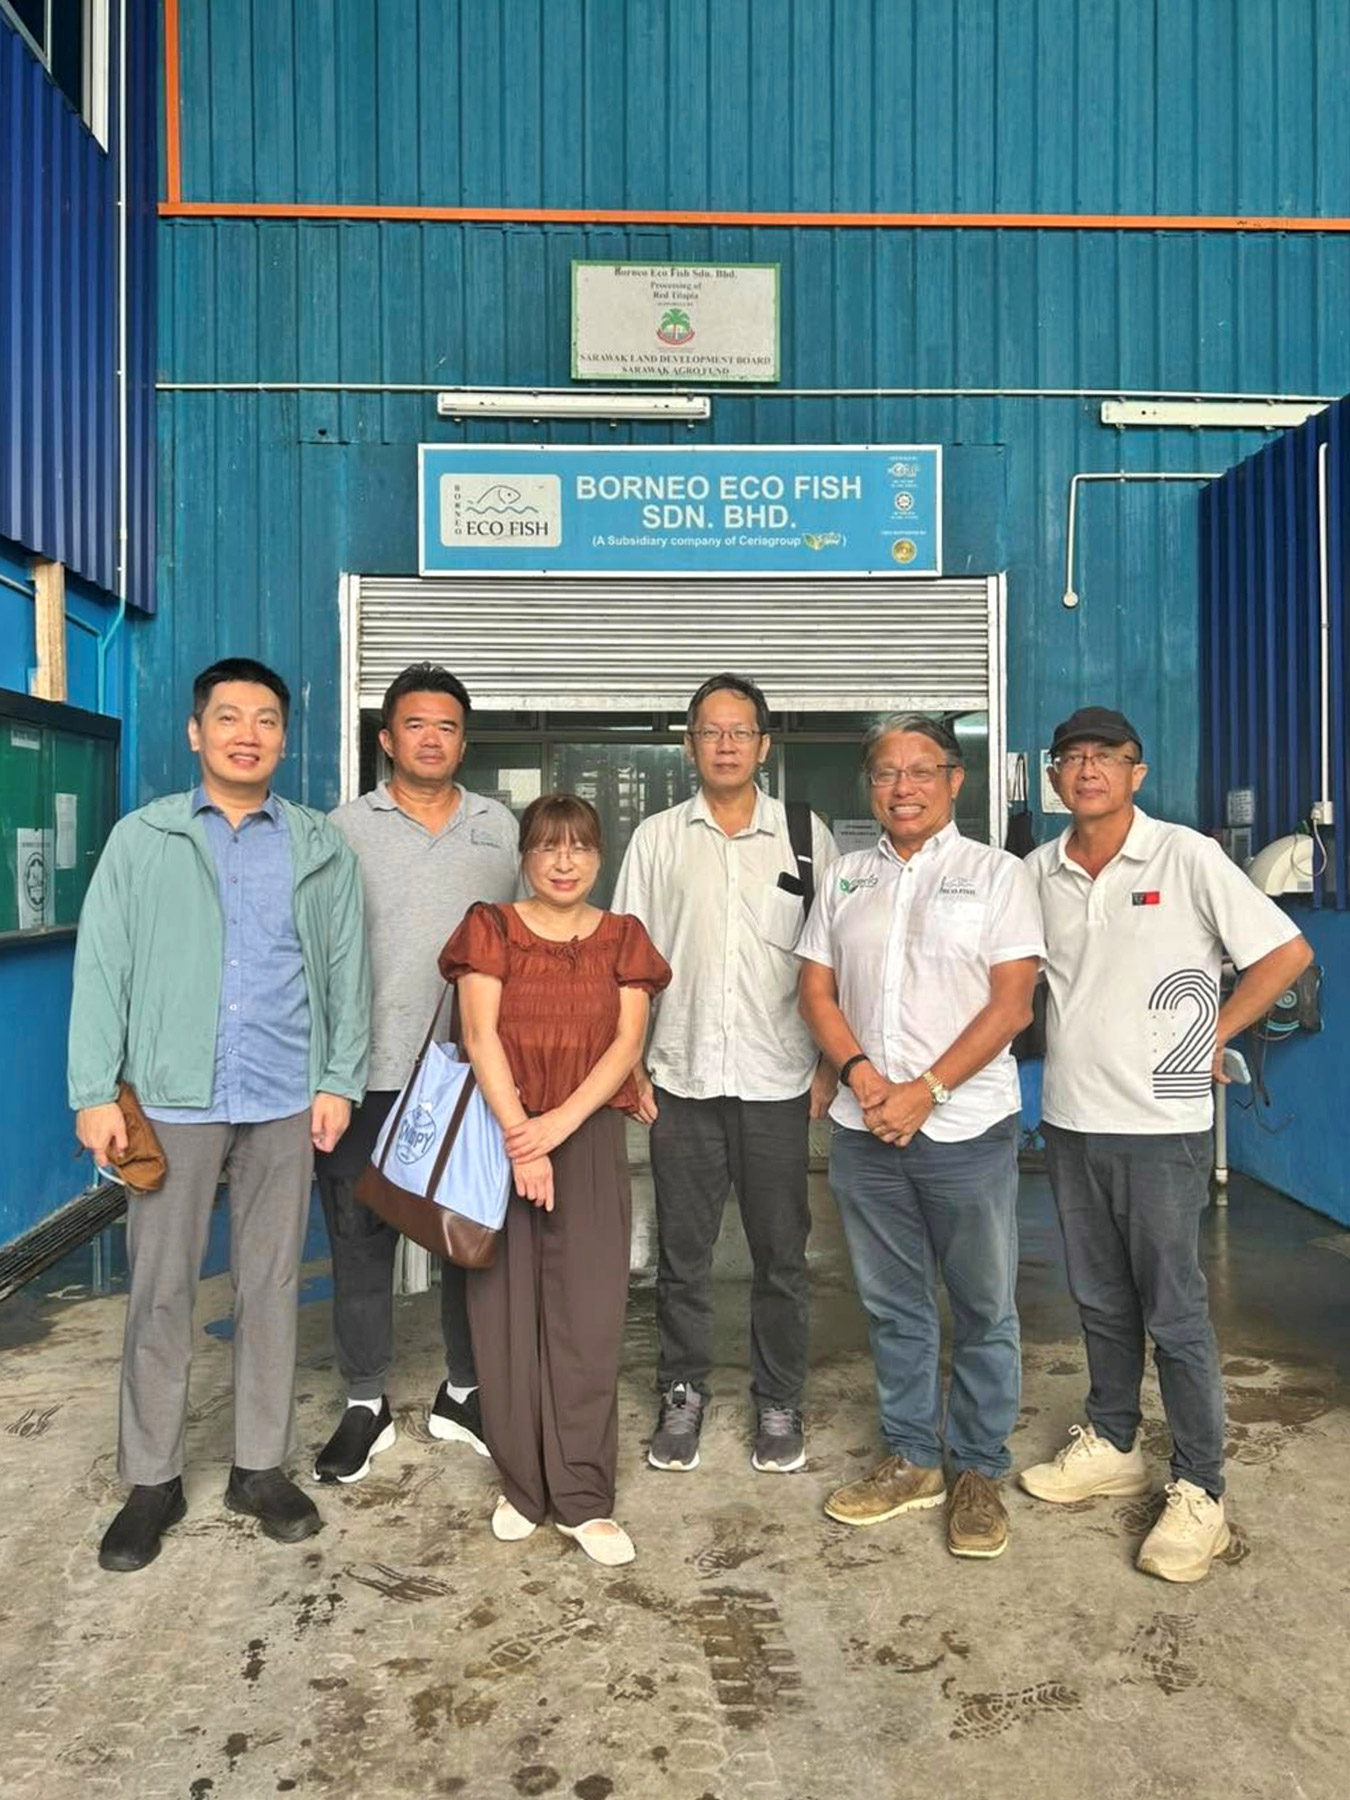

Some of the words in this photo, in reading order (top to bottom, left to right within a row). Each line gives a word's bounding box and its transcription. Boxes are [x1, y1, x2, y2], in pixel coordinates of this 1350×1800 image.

[614, 266, 648, 276] Borneo
[650, 269, 668, 277] Eco
[670, 267, 690, 278] Fish
[692, 269, 713, 278] Sdn.
[715, 270, 738, 279] Bhd.
[653, 291, 669, 299] Red
[580, 354, 628, 362] SARAWAK
[630, 354, 658, 363] LAND
[660, 355, 733, 364] DEVELOPMENT
[736, 356, 771, 364] BOARD
[622, 366, 670, 376] SARAWAK
[576, 475, 710, 500] BORNEO
[719, 475, 785, 500] ECO
[794, 475, 862, 499] FISH
[642, 504, 713, 529] SDN.
[724, 505, 797, 529] BHD.
[466, 521, 504, 536] ECO
[510, 521, 548, 536] FISH
[592, 535, 605, 547] (A
[607, 535, 668, 548] Subsidiary
[670, 536, 721, 548] company
[725, 535, 736, 546] of
[739, 535, 801, 548] Ceriagroup
[1148, 968, 1219, 1100] 2
